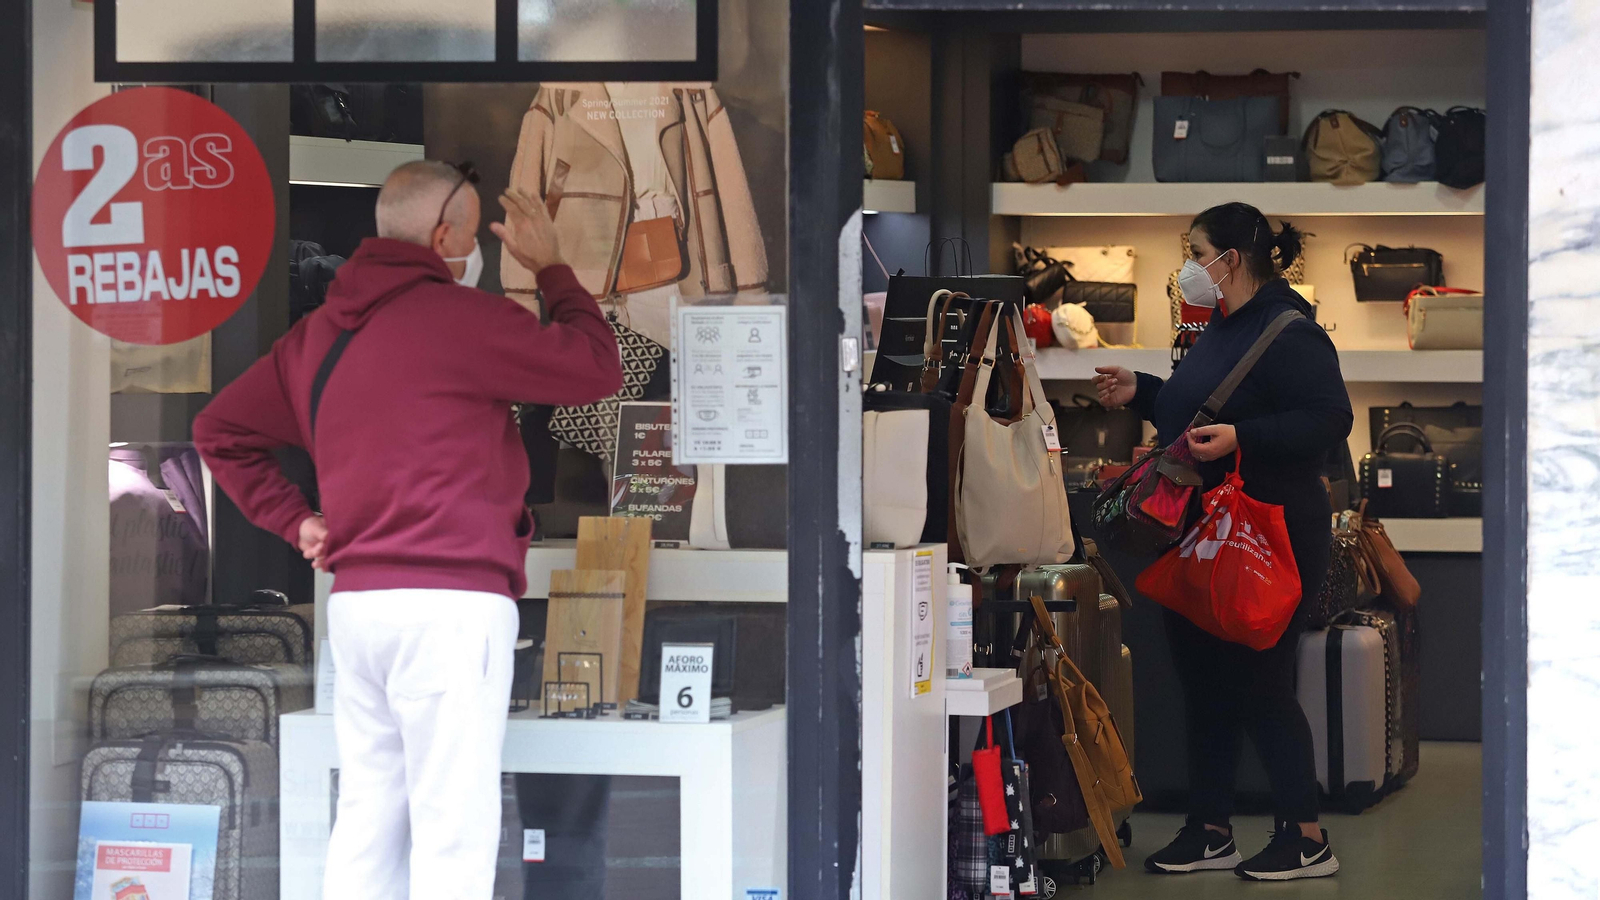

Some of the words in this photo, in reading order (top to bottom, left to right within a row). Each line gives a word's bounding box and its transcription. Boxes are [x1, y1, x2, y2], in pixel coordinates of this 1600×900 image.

[582, 98, 647, 108] Spring/Summer
[649, 96, 669, 106] 2021
[587, 111, 607, 120] NEW
[609, 109, 665, 120] COLLECTION
[67, 246, 241, 305] REBAJAS
[635, 423, 671, 431] BISUTE
[632, 450, 671, 458] FULARE
[628, 504, 682, 512] BUFANDAS
[668, 655, 704, 664] AFORO
[664, 664, 709, 674] MÁXIMO
[676, 686, 693, 709] 6
[105, 847, 164, 858] MASCARILLAS
[104, 856, 116, 865] DE
